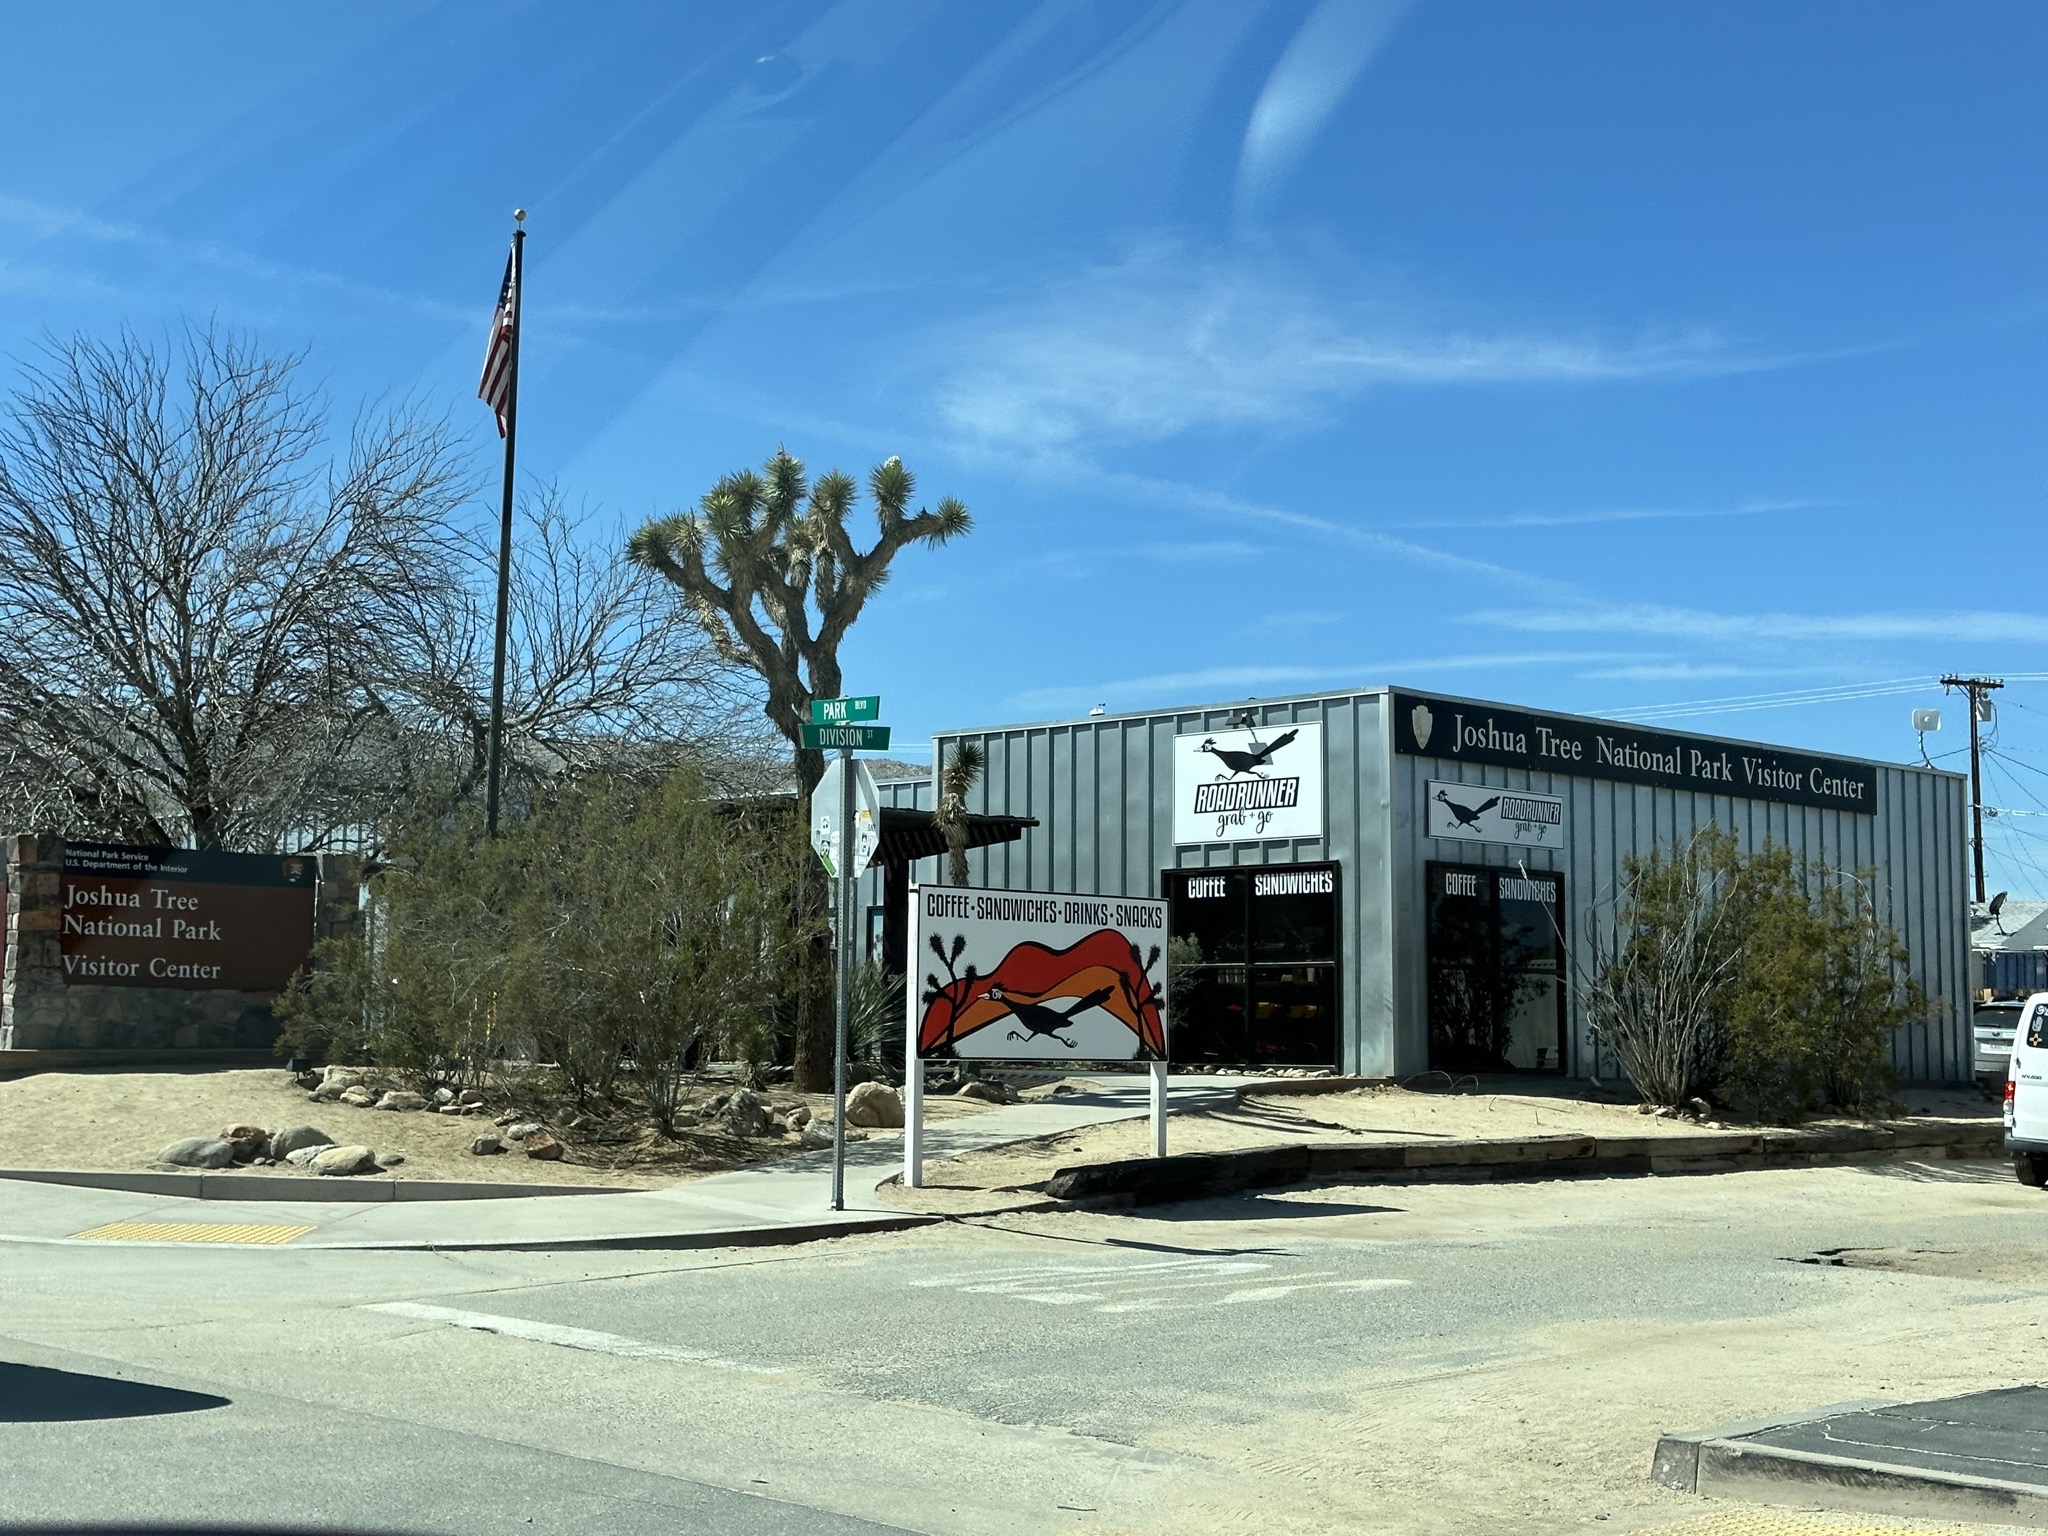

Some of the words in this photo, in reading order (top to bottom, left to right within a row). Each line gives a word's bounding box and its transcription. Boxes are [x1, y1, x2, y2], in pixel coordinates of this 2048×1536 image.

[823, 701, 847, 720] PARK
[854, 700, 867, 710] BLVD
[819, 728, 863, 746] DIVISION
[867, 729, 874, 739] ST
[1453, 714, 1527, 753] Joshua
[1536, 726, 1582, 761] Tree
[1596, 735, 1682, 776] National
[1690, 749, 1733, 782] Park
[1742, 757, 1803, 791] Visitor
[1809, 767, 1864, 799] Center
[1196, 778, 1297, 813] ROADRUNNER
[1216, 807, 1247, 837] grab
[1255, 810, 1274, 834] go
[1502, 798, 1560, 824] ROADRUNNER
[1514, 820, 1532, 839] grab
[1537, 823, 1547, 841] go
[65, 849, 99, 858] National
[102, 850, 118, 859] Park
[121, 852, 149, 861] Service
[83, 860, 130, 869] Department
[145, 863, 157, 871] the
[160, 864, 188, 873] Interior
[1188, 876, 1226, 898] COFFEE
[1254, 870, 1333, 896] SANDWICHES
[1445, 872, 1476, 897] COFFEE
[1499, 877, 1556, 903] SANDWICHES
[64, 884, 141, 910] Joshua
[150, 887, 199, 912] Tree
[927, 893, 969, 918] COFFEE
[977, 896, 1057, 923] SANDWICHES
[1064, 901, 1108, 926] DRINKS
[1116, 904, 1162, 929] SNACKS
[63, 914, 162, 939] National
[172, 920, 222, 941] Park
[62, 954, 140, 978] Visitor
[150, 957, 221, 980] Center
